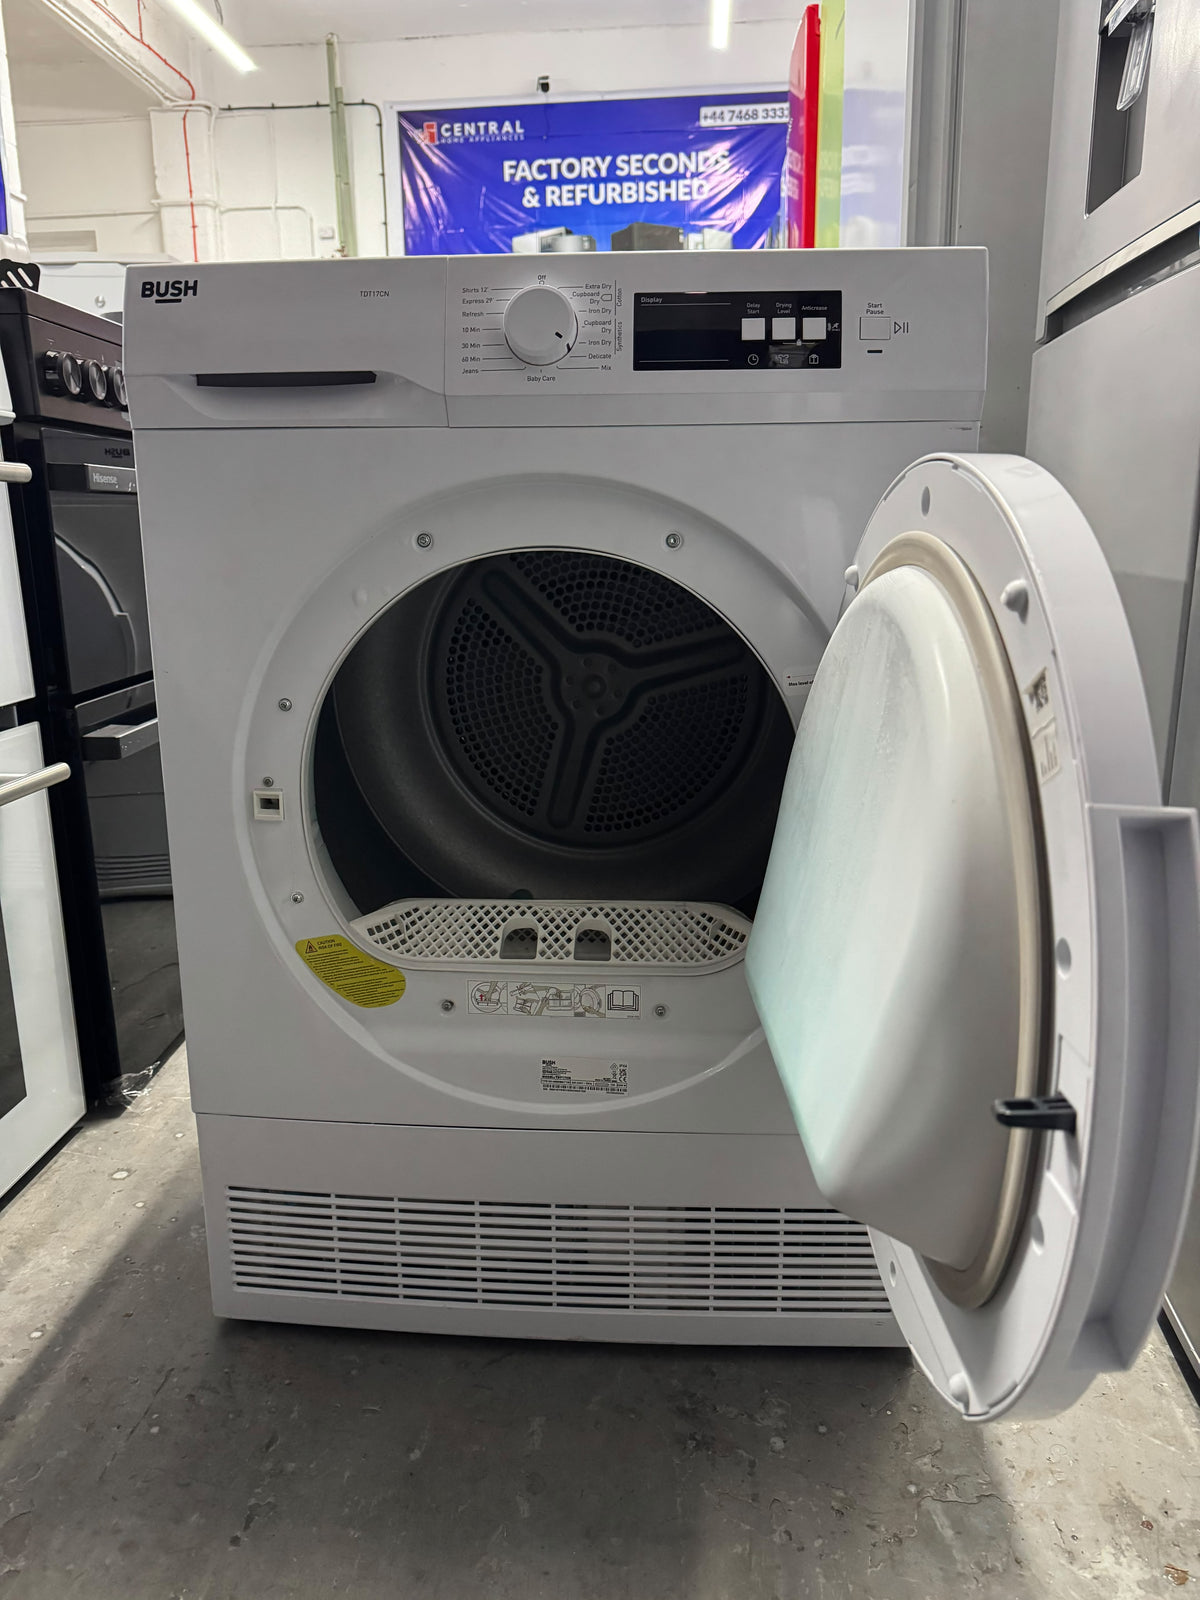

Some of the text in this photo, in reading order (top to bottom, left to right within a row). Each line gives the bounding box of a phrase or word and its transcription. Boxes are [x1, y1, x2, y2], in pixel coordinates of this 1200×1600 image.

[702, 111, 725, 122] +44
[727, 109, 759, 121] 7468
[440, 120, 525, 137] CENTRAL
[502, 150, 730, 182] FACTORY SECONDS
[522, 178, 709, 208] & REFURBISHED
[141, 280, 198, 299] BUSH
[360, 290, 390, 298] TDT17CN
[640, 296, 663, 304] Display
[601, 307, 612, 315] Dry
[616, 321, 624, 352] Synthetics
[93, 472, 118, 484] Hisense
